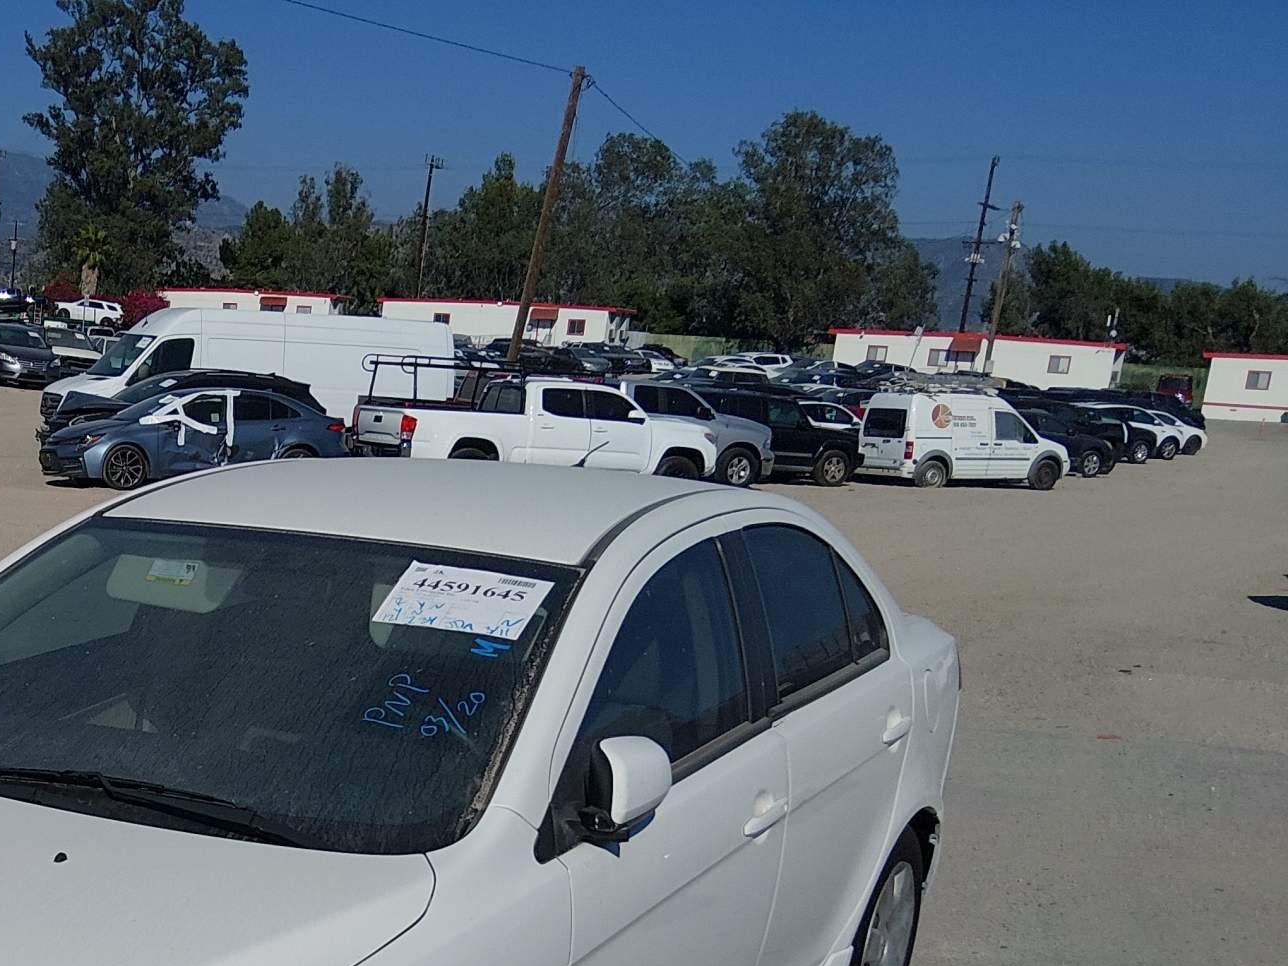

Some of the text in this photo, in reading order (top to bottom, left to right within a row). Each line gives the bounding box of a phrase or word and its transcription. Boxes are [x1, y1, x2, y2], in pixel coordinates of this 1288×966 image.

[414, 577, 528, 602] 44591645
[362, 673, 430, 728] PNP
[420, 692, 486, 737] 03/20
